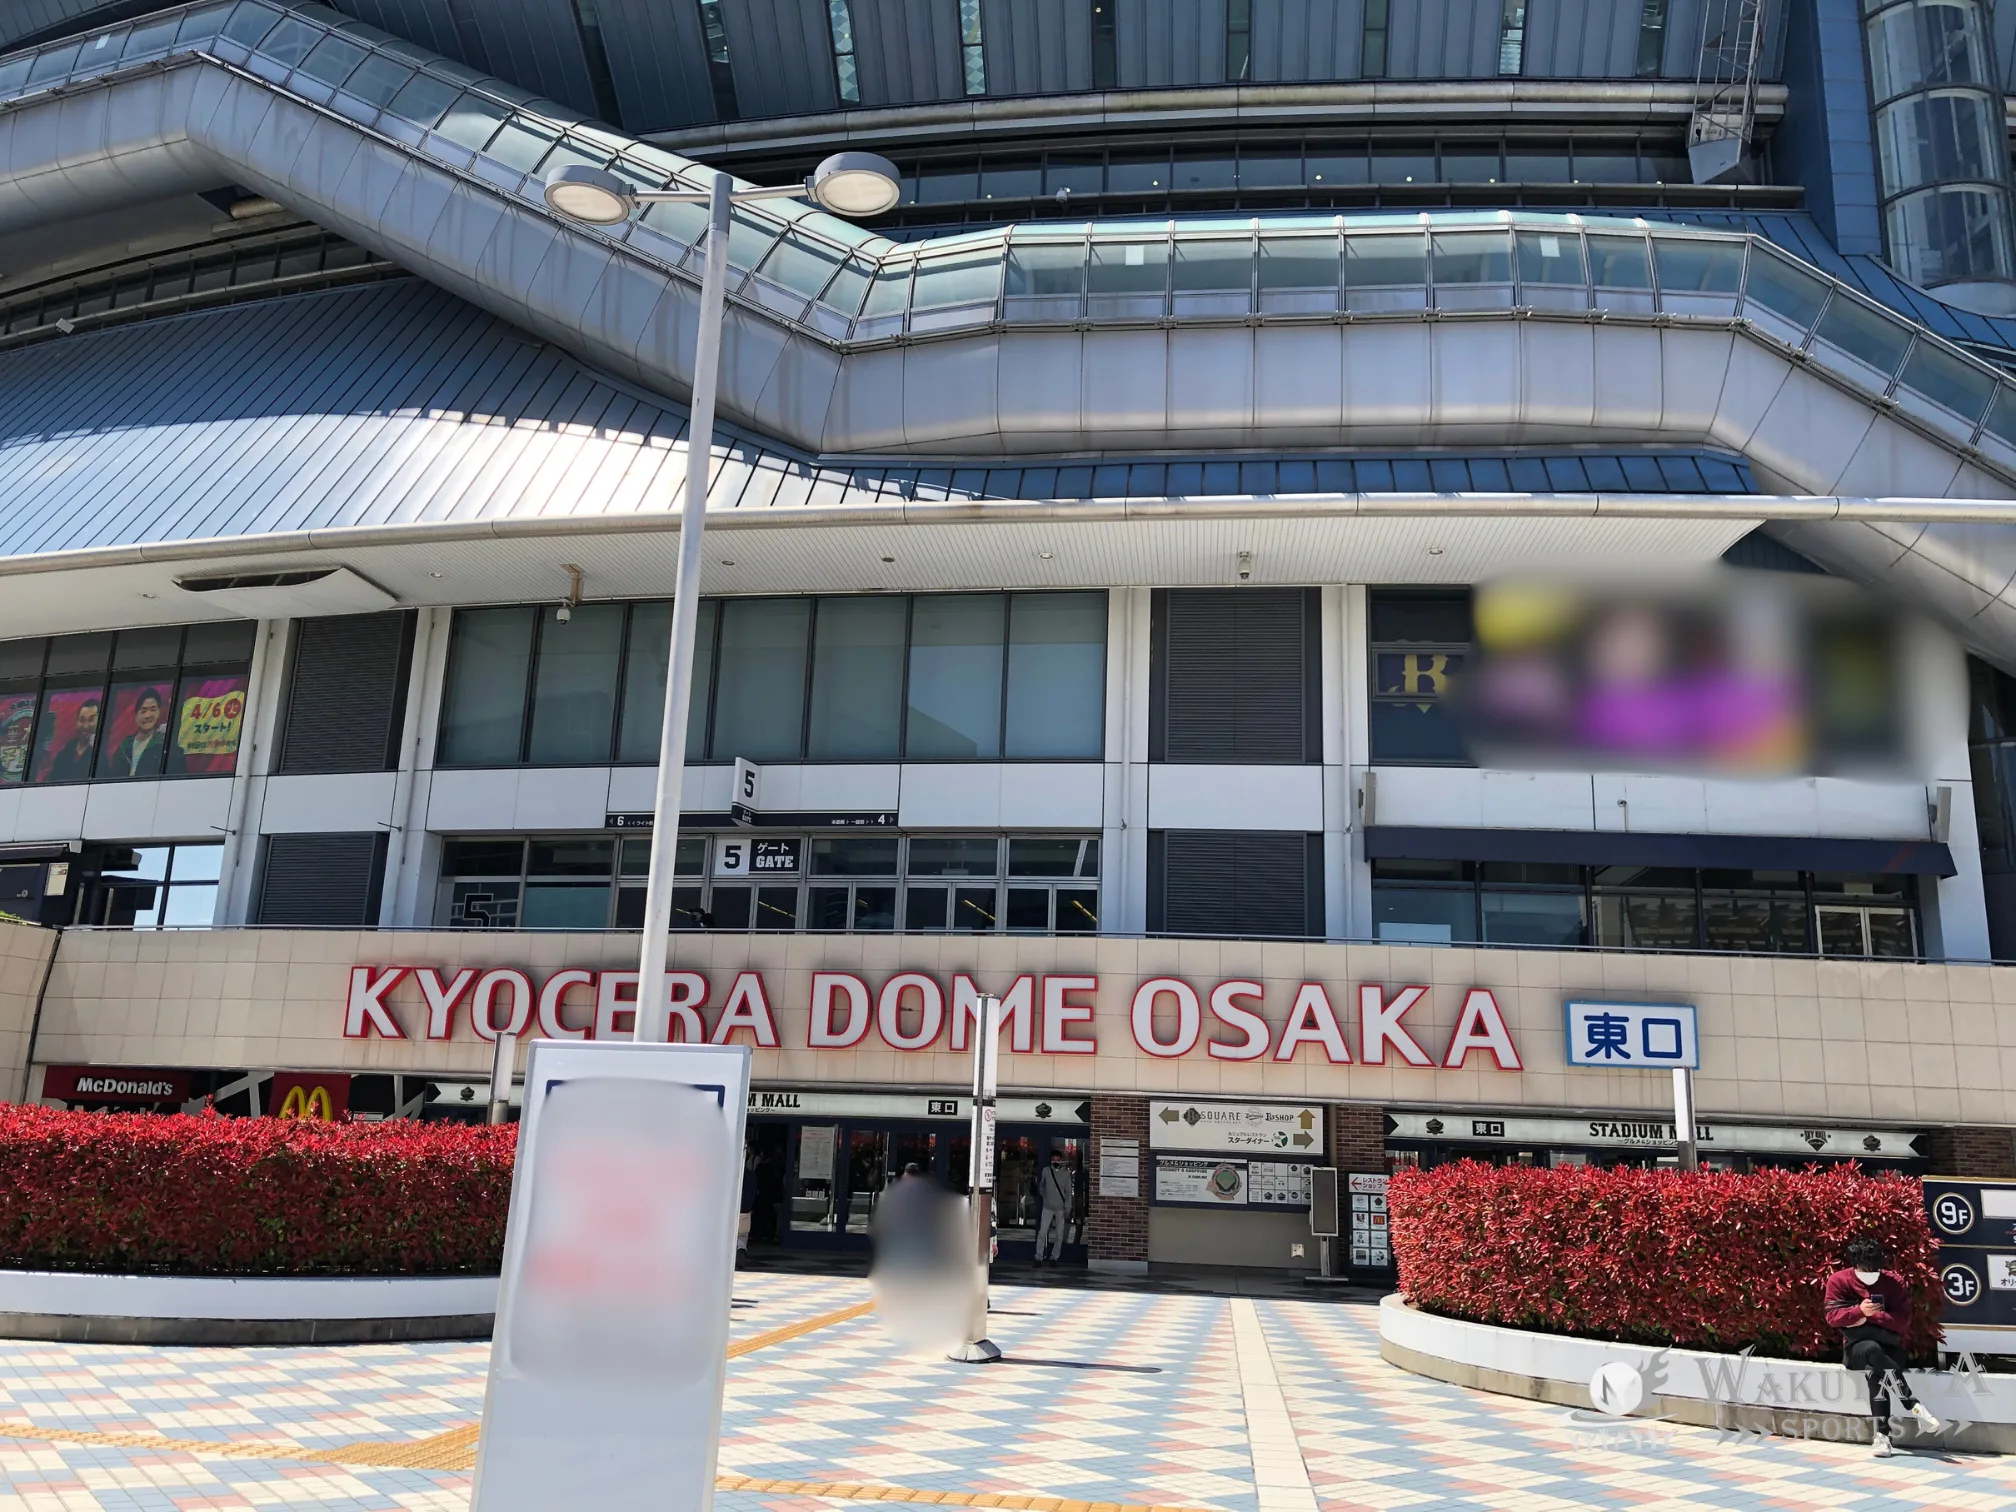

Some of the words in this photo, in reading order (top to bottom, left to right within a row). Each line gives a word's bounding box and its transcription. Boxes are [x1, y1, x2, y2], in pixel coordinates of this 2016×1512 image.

[744, 769, 755, 798] 5
[617, 815, 625, 826] 6
[877, 814, 885, 825] 4
[723, 845, 742, 869] 5
[757, 842, 790, 854] ゲート
[755, 855, 794, 868] GATE
[343, 966, 781, 1048] KYOCERA
[807, 971, 1099, 1054] DOME
[1130, 976, 1524, 1071] OSAKA
[1583, 1011, 1684, 1060] 東口
[76, 1076, 173, 1096] McDonald's
[761, 1093, 801, 1108] MALL
[930, 1101, 956, 1114] 東口
[1200, 1110, 1242, 1121] SQUARE
[1474, 1122, 1502, 1136] 東口
[1589, 1122, 1664, 1140] STADIUM
[1669, 1125, 1714, 1141] MLL
[1940, 1201, 1968, 1226] 9F
[1947, 1272, 1975, 1297] 3F
